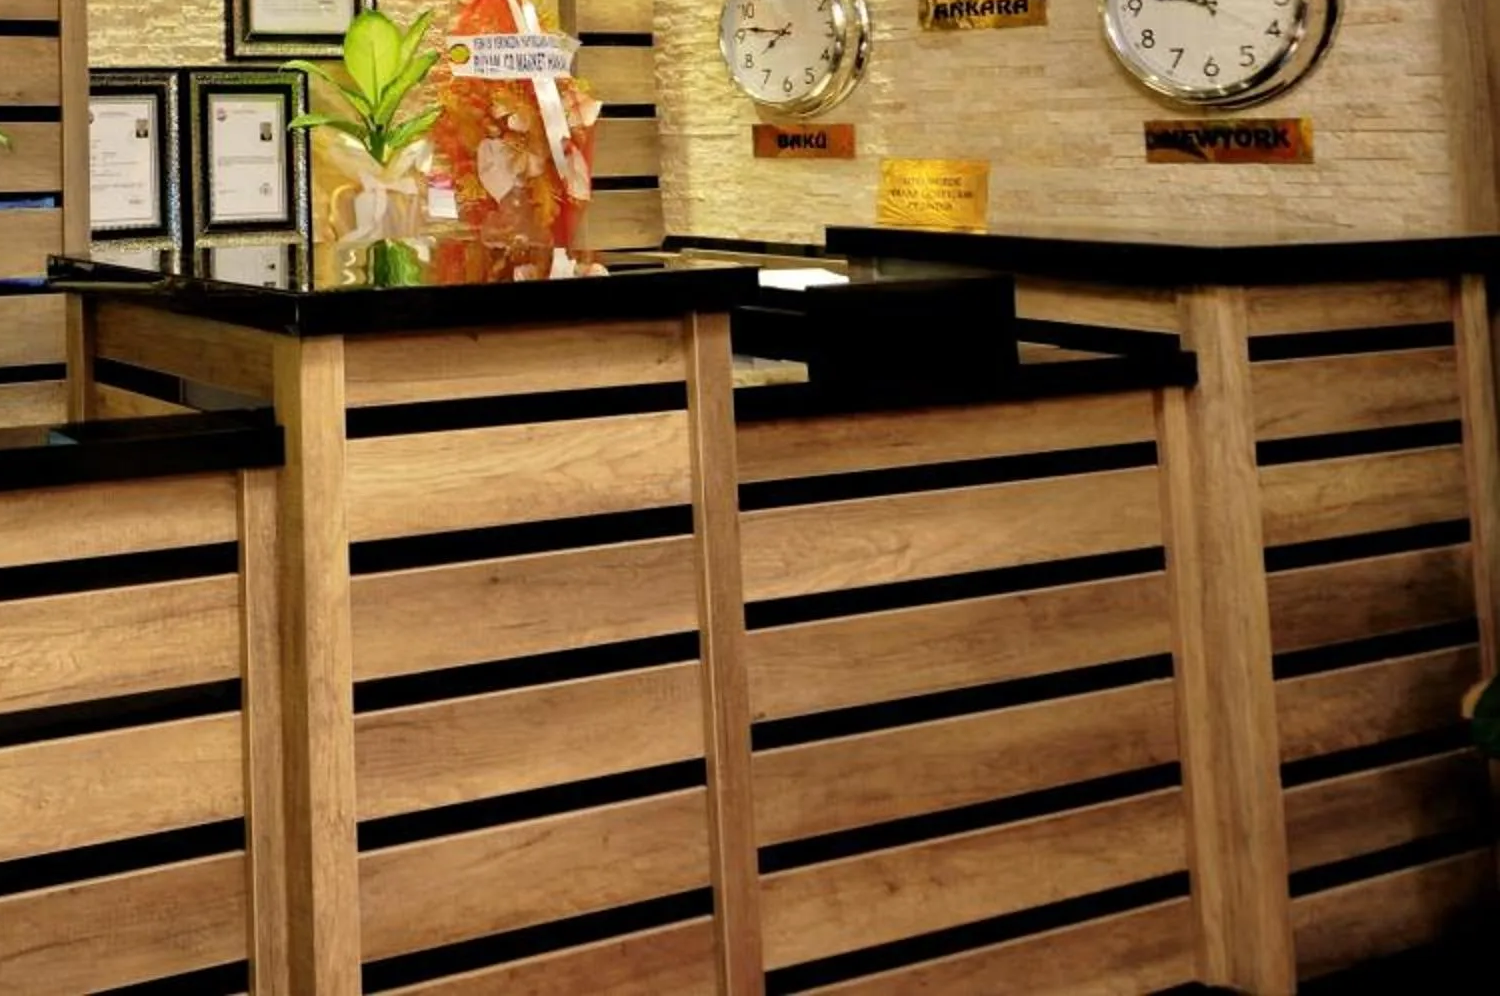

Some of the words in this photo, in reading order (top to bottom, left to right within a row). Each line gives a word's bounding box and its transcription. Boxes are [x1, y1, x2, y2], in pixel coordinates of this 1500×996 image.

[741, 2, 754, 20] 10
[825, 22, 834, 37] 3
[1265, 20, 1281, 37] 4
[1141, 29, 1155, 48] 8
[745, 54, 754, 68] 8
[821, 50, 830, 61] 4
[1170, 48, 1184, 68] 7
[1239, 45, 1255, 67] 5
[1203, 56, 1220, 77] 6
[762, 70, 772, 84] 7
[804, 68, 814, 84] 5
[783, 77, 793, 92] 6
